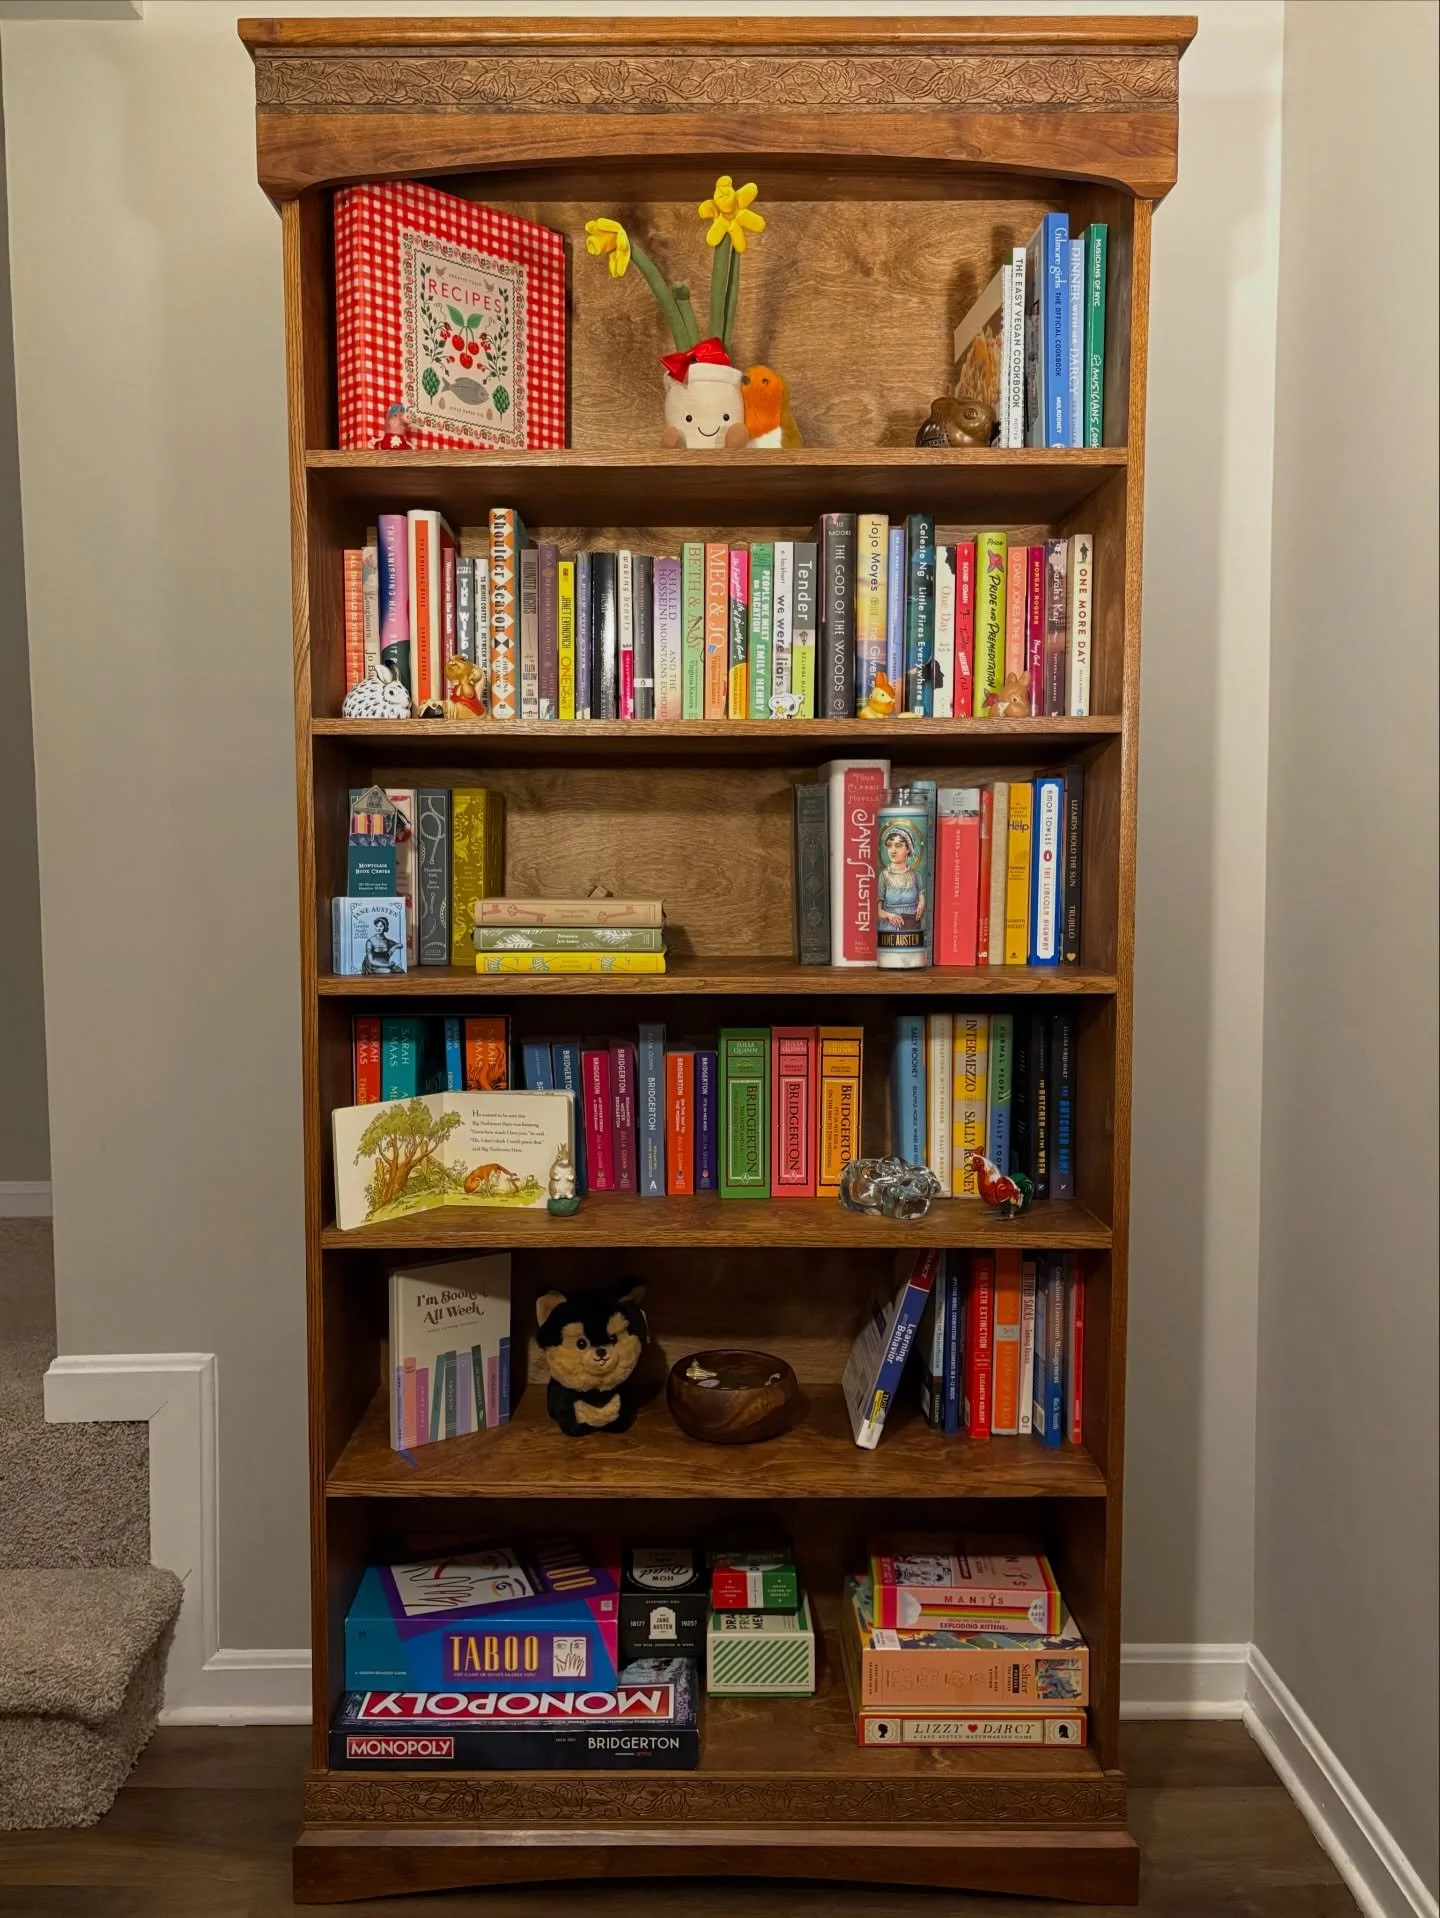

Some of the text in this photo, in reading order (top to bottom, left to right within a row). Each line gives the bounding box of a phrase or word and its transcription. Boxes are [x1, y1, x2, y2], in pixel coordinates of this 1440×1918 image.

[1054, 227, 1068, 265] Gilmore
[428, 279, 504, 314] RECIPES
[1050, 266, 1067, 288] girls
[1094, 280, 1101, 291] OF
[1012, 258, 1023, 408] THE EASY VEGAN COOKBOOK
[1054, 308, 1062, 338] OFFICIAL
[386, 525, 394, 541] THE
[916, 523, 928, 577] Celeste Ng
[351, 555, 359, 569] ALL
[387, 546, 396, 596] VANISHING
[493, 514, 507, 633] Shoulder Season
[688, 547, 702, 592] BETH
[868, 521, 882, 592] Jojo Moyes
[1012, 564, 1022, 588] DAISY
[350, 588, 358, 610] COULD
[522, 561, 537, 614] HAUNTED NIGHTS
[658, 570, 668, 622] HOSSEINI
[668, 570, 677, 621] KHALED
[688, 596, 702, 609] &
[709, 547, 726, 649] MEG & JO
[762, 570, 770, 641] PEOPLE WE MEET
[798, 560, 812, 621] Tender
[1012, 590, 1022, 616] JONES
[752, 592, 761, 632] VACATION
[834, 544, 844, 692] THE GOD OF THE WOODS
[986, 574, 1002, 688] PRIDE AND PREMEDITATION
[1049, 604, 1062, 622] Key
[1078, 568, 1088, 665] ONE MORE DAY
[560, 596, 572, 686] JANET EVANOVICH ONE
[776, 595, 788, 688] we were liars
[915, 587, 926, 701] Little Fires Everywhere
[1012, 626, 1022, 641] THE
[660, 623, 668, 719] MOUNTAINS ECHOED
[756, 644, 766, 711] EMILY HENRY
[1008, 822, 1030, 833] Help
[1045, 790, 1053, 845] AMOR TOWLES
[1070, 800, 1078, 830] LIZARDS
[1070, 832, 1078, 854] HOLD
[846, 809, 876, 932] JANE AUSTEN
[352, 906, 400, 920] JANE AUSTEN
[1068, 905, 1076, 940] TRUJILLO
[1042, 920, 1050, 951] HIGHWAY
[400, 1028, 409, 1064] SARAH
[910, 1026, 918, 1078] SALLY ROONEY
[964, 1019, 977, 1092] INTERMEZZO
[998, 1026, 1006, 1102] NORMAL PEOPLE
[562, 1050, 572, 1089] BRIDGERTO
[592, 1057, 600, 1094] BRIDGERTON
[618, 1049, 626, 1094] BRIDGERTON
[648, 1077, 656, 1131] BRIDGERTON
[1058, 1100, 1070, 1145] BUTCHER
[746, 1086, 758, 1173] BRIDGERTON
[789, 1083, 800, 1172] BRIDGERTON
[840, 1084, 852, 1172] BRIDGERTON
[964, 1111, 976, 1146] SALLY
[996, 1112, 1004, 1140] SALLY
[424, 1302, 485, 1325] All Week
[980, 1284, 988, 1305] SIXTH
[1024, 1300, 1035, 1320] SACKS
[979, 1306, 988, 1348] EXTINCTION
[1054, 1302, 1062, 1340] Classroom
[886, 1324, 906, 1364] Behavior
[895, 1323, 916, 1363] Learning
[1052, 1341, 1061, 1384] Management
[1052, 1398, 1060, 1430] Rick Smith
[450, 1635, 540, 1672] TABOO
[1022, 1664, 1031, 1694] Seltzer
[370, 1690, 661, 1715] MONOPOLY
[352, 1740, 450, 1755] MONOPOLY
[588, 1736, 680, 1750] BRIDGERTON
[914, 1724, 1034, 1734] LIZZY DARCY
